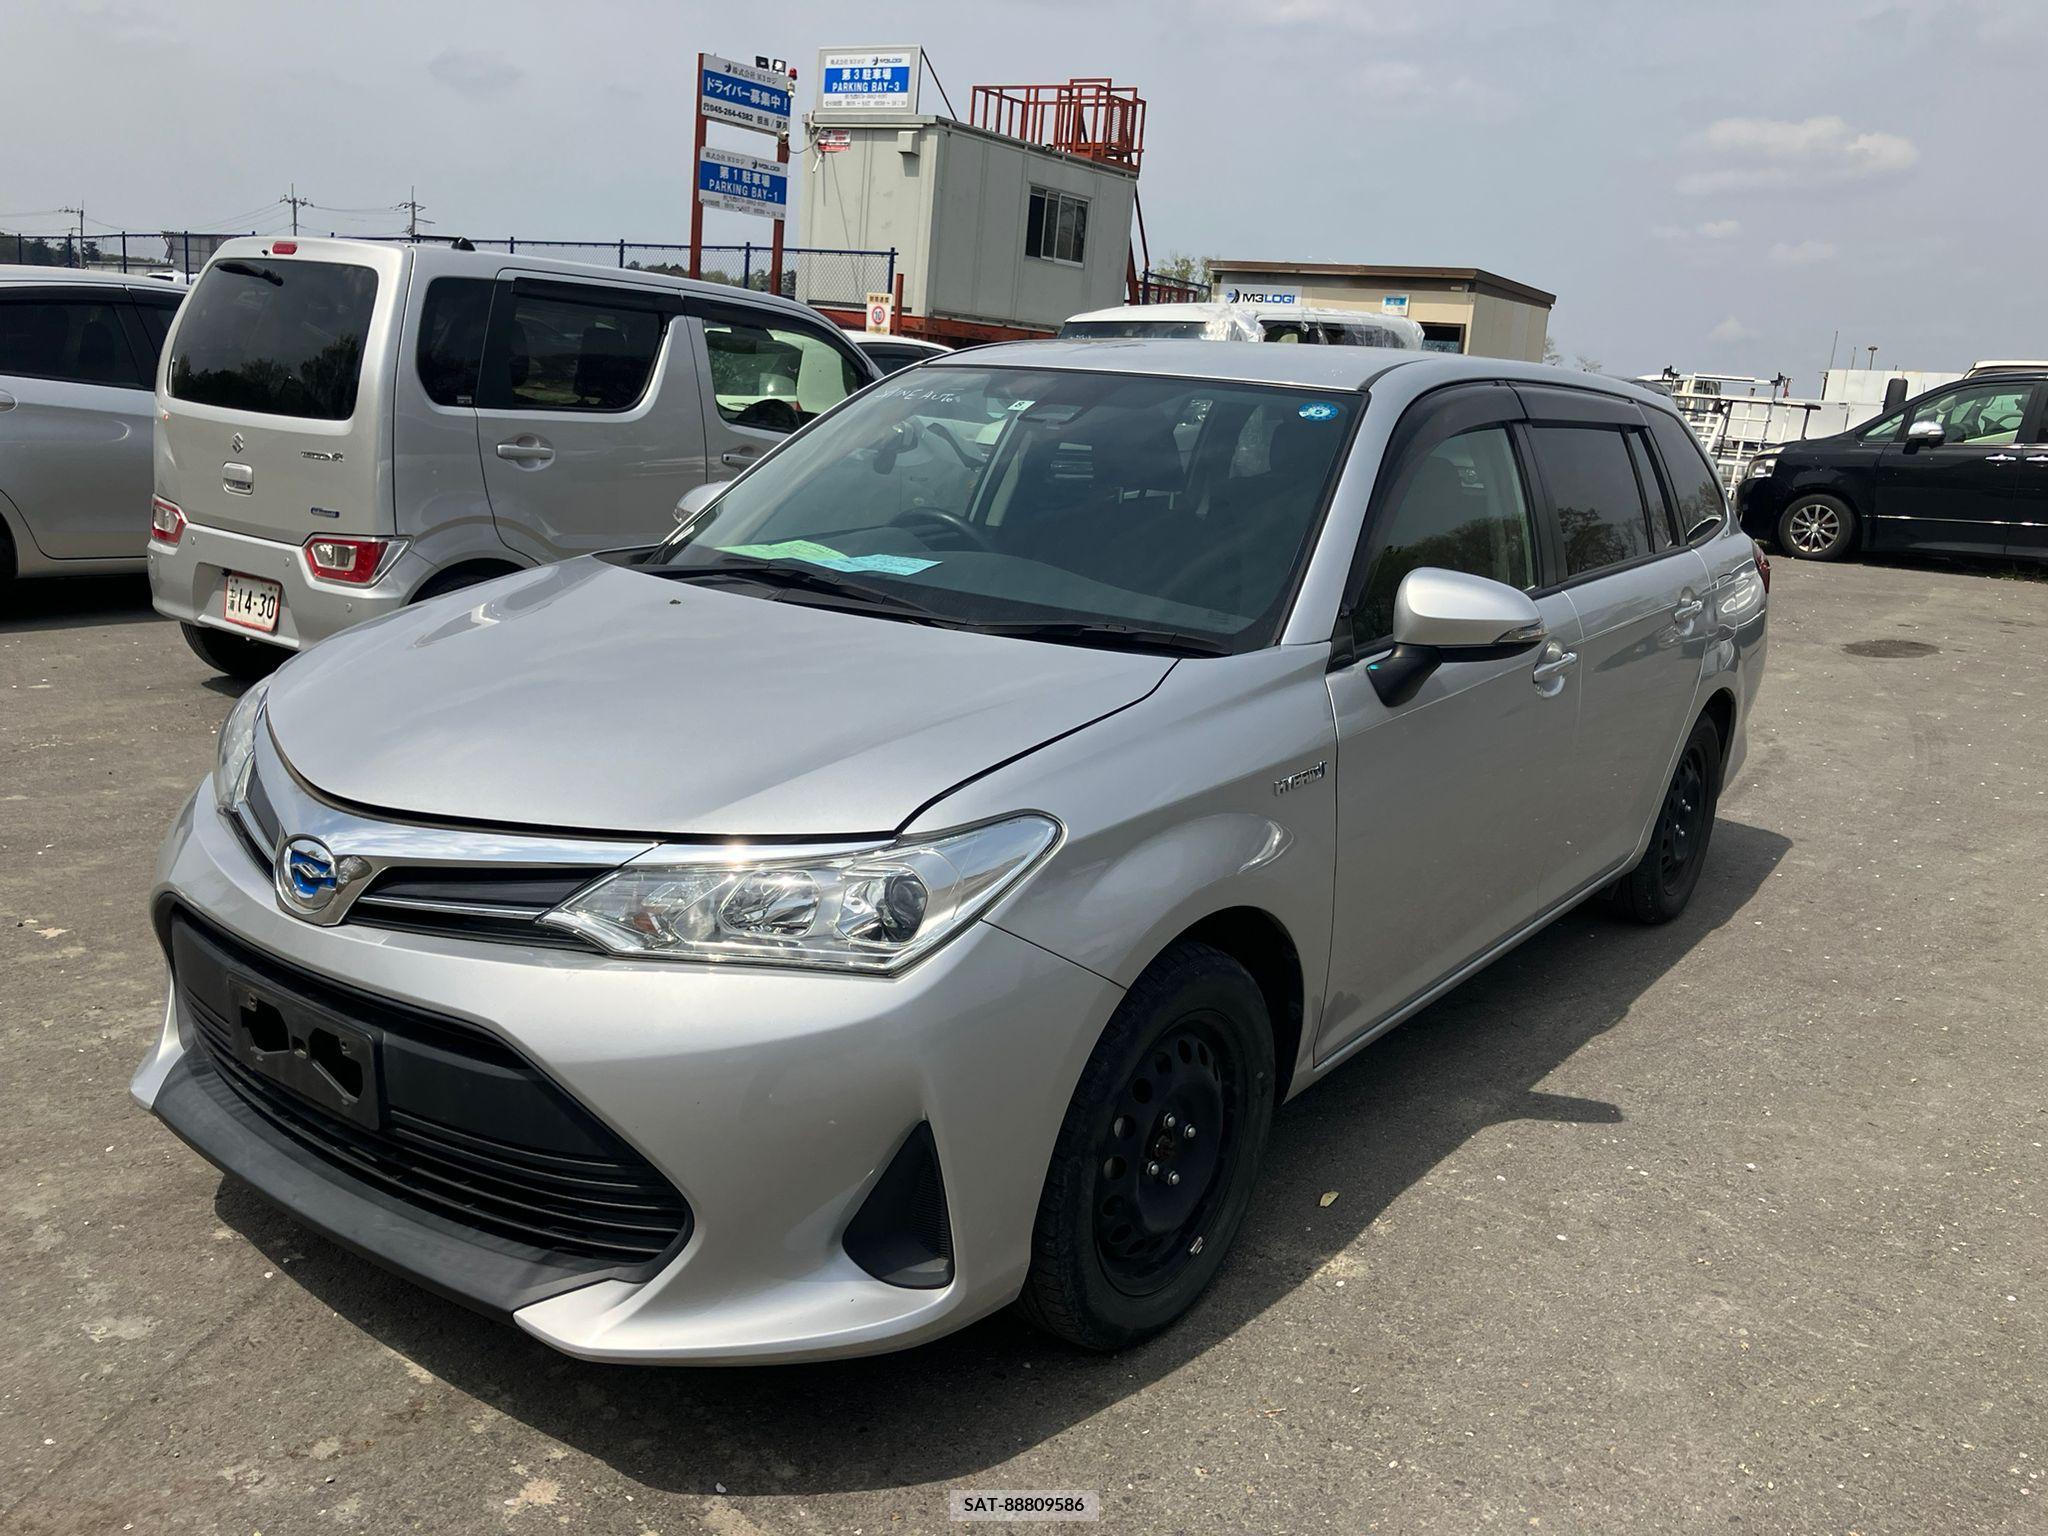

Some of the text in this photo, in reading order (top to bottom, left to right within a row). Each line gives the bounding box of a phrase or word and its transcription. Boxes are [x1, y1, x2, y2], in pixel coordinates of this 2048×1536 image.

[832, 82, 900, 92] PARKING BAY-3
[708, 179, 748, 196] PARKING
[751, 187, 778, 201] BAY-1
[1242, 293, 1296, 304] M3LOGI
